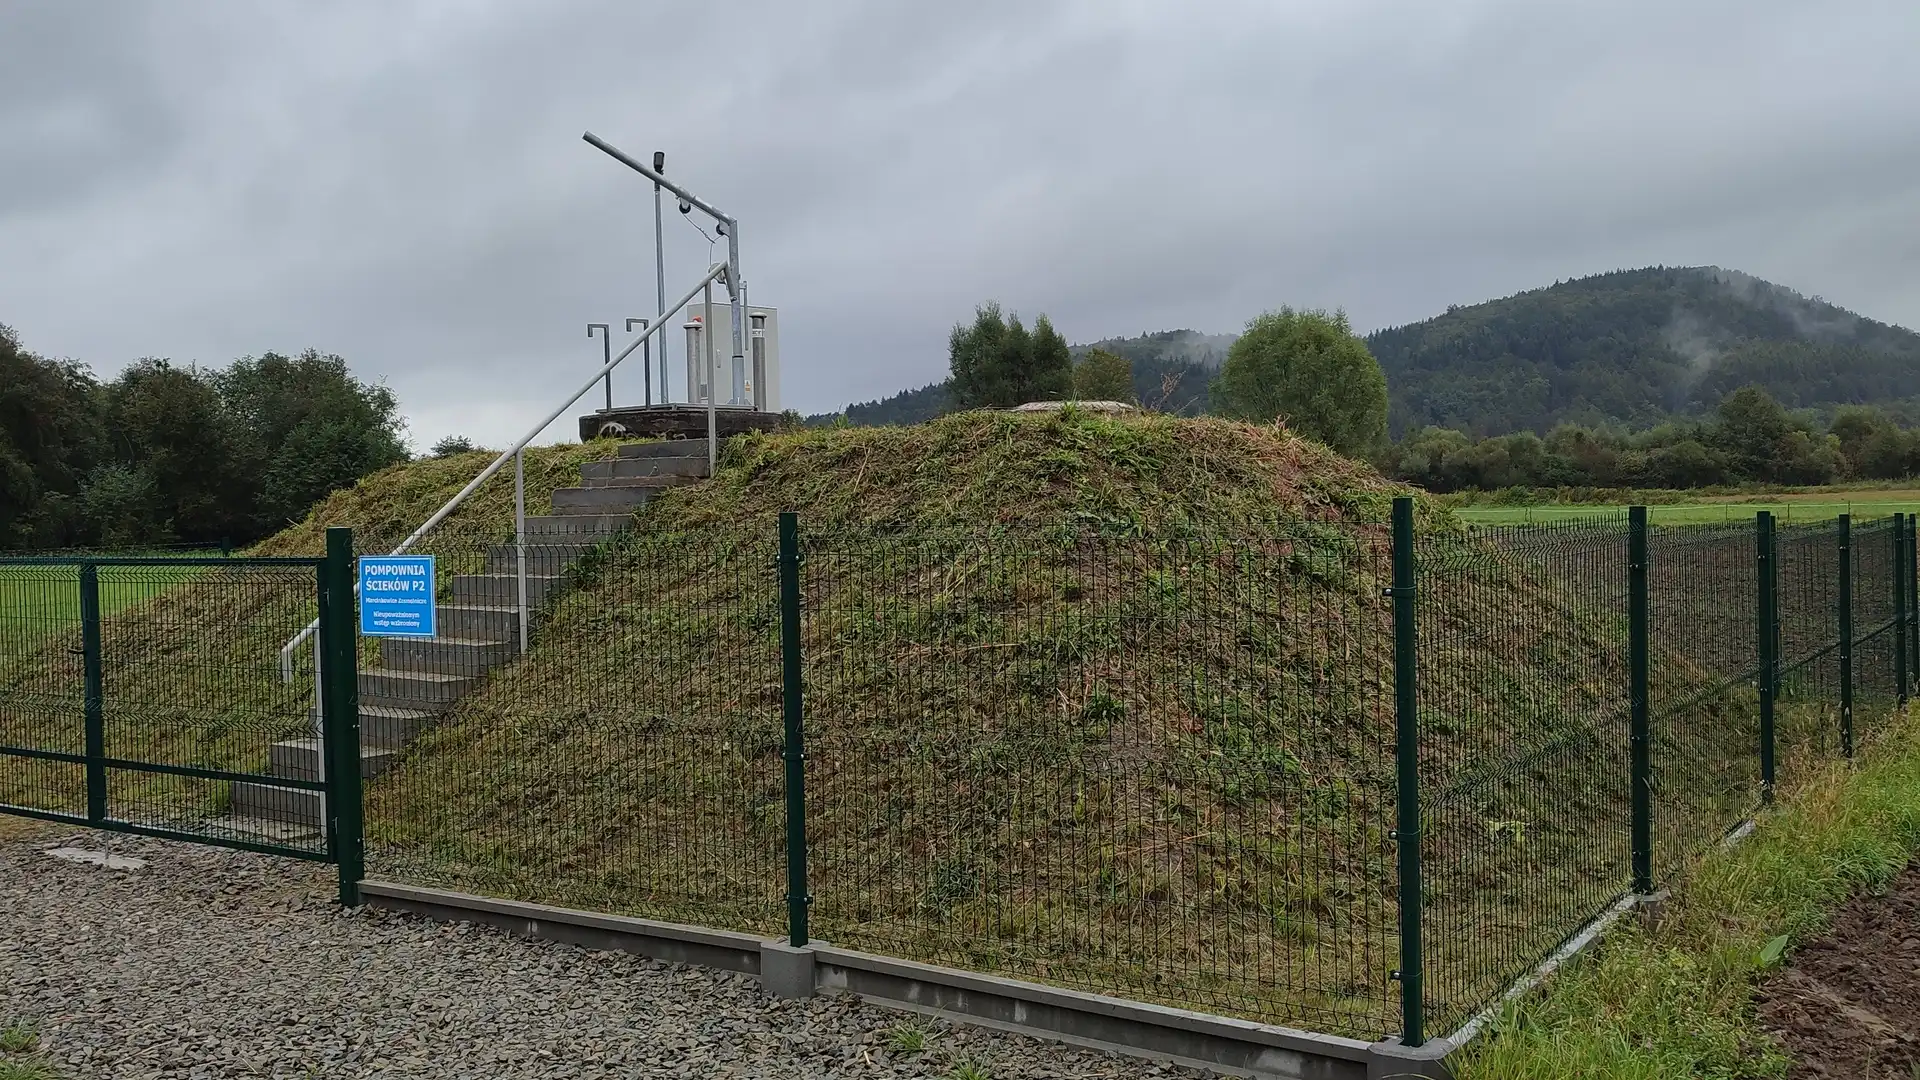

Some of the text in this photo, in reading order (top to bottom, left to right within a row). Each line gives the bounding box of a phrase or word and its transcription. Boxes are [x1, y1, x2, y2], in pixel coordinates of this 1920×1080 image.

[365, 565, 425, 575] POMPOWNIA
[366, 577, 425, 591] ŚCIEKÓW P2
